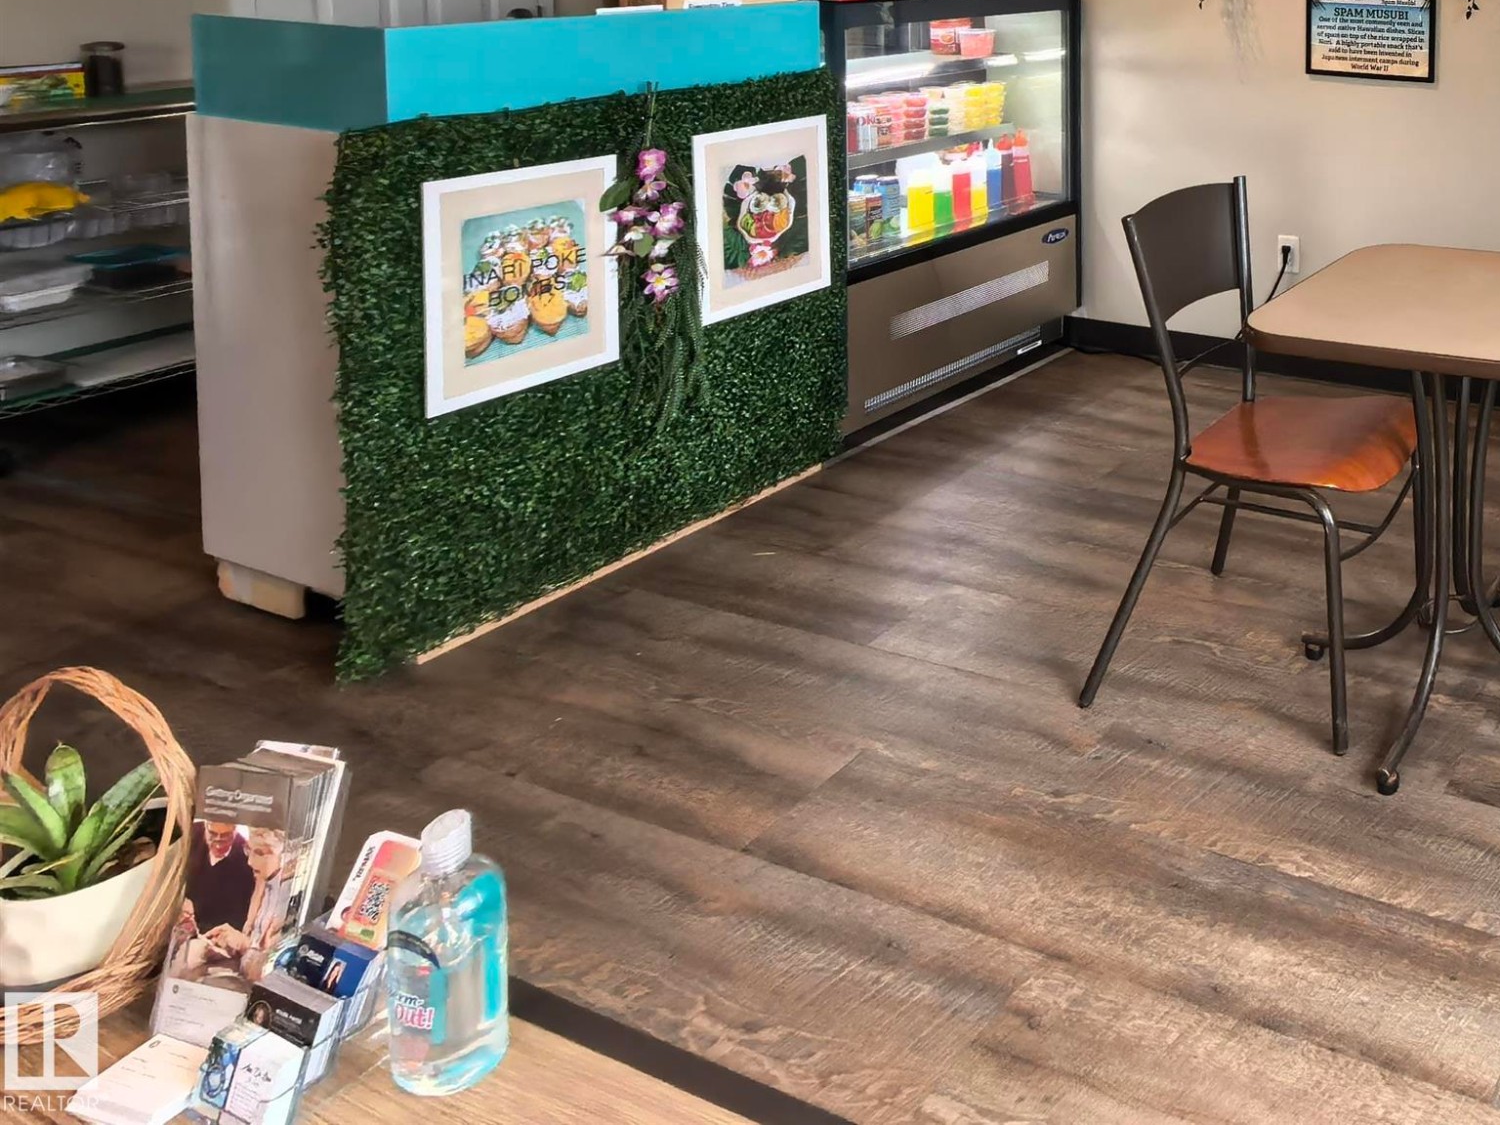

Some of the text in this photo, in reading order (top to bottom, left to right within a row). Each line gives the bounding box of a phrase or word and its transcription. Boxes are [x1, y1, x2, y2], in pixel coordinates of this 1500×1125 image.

[1334, 7, 1409, 21] SPAM MUSUBI
[1350, 17, 1364, 25] most
[1357, 25, 1386, 33] Hawaiian
[1368, 33, 1378, 41] the
[1360, 41, 1386, 49] portable
[1378, 50, 1405, 58] invented
[1370, 63, 1382, 71] War
[1399, 59, 1420, 67] during
[463, 247, 586, 290] INARI POKE
